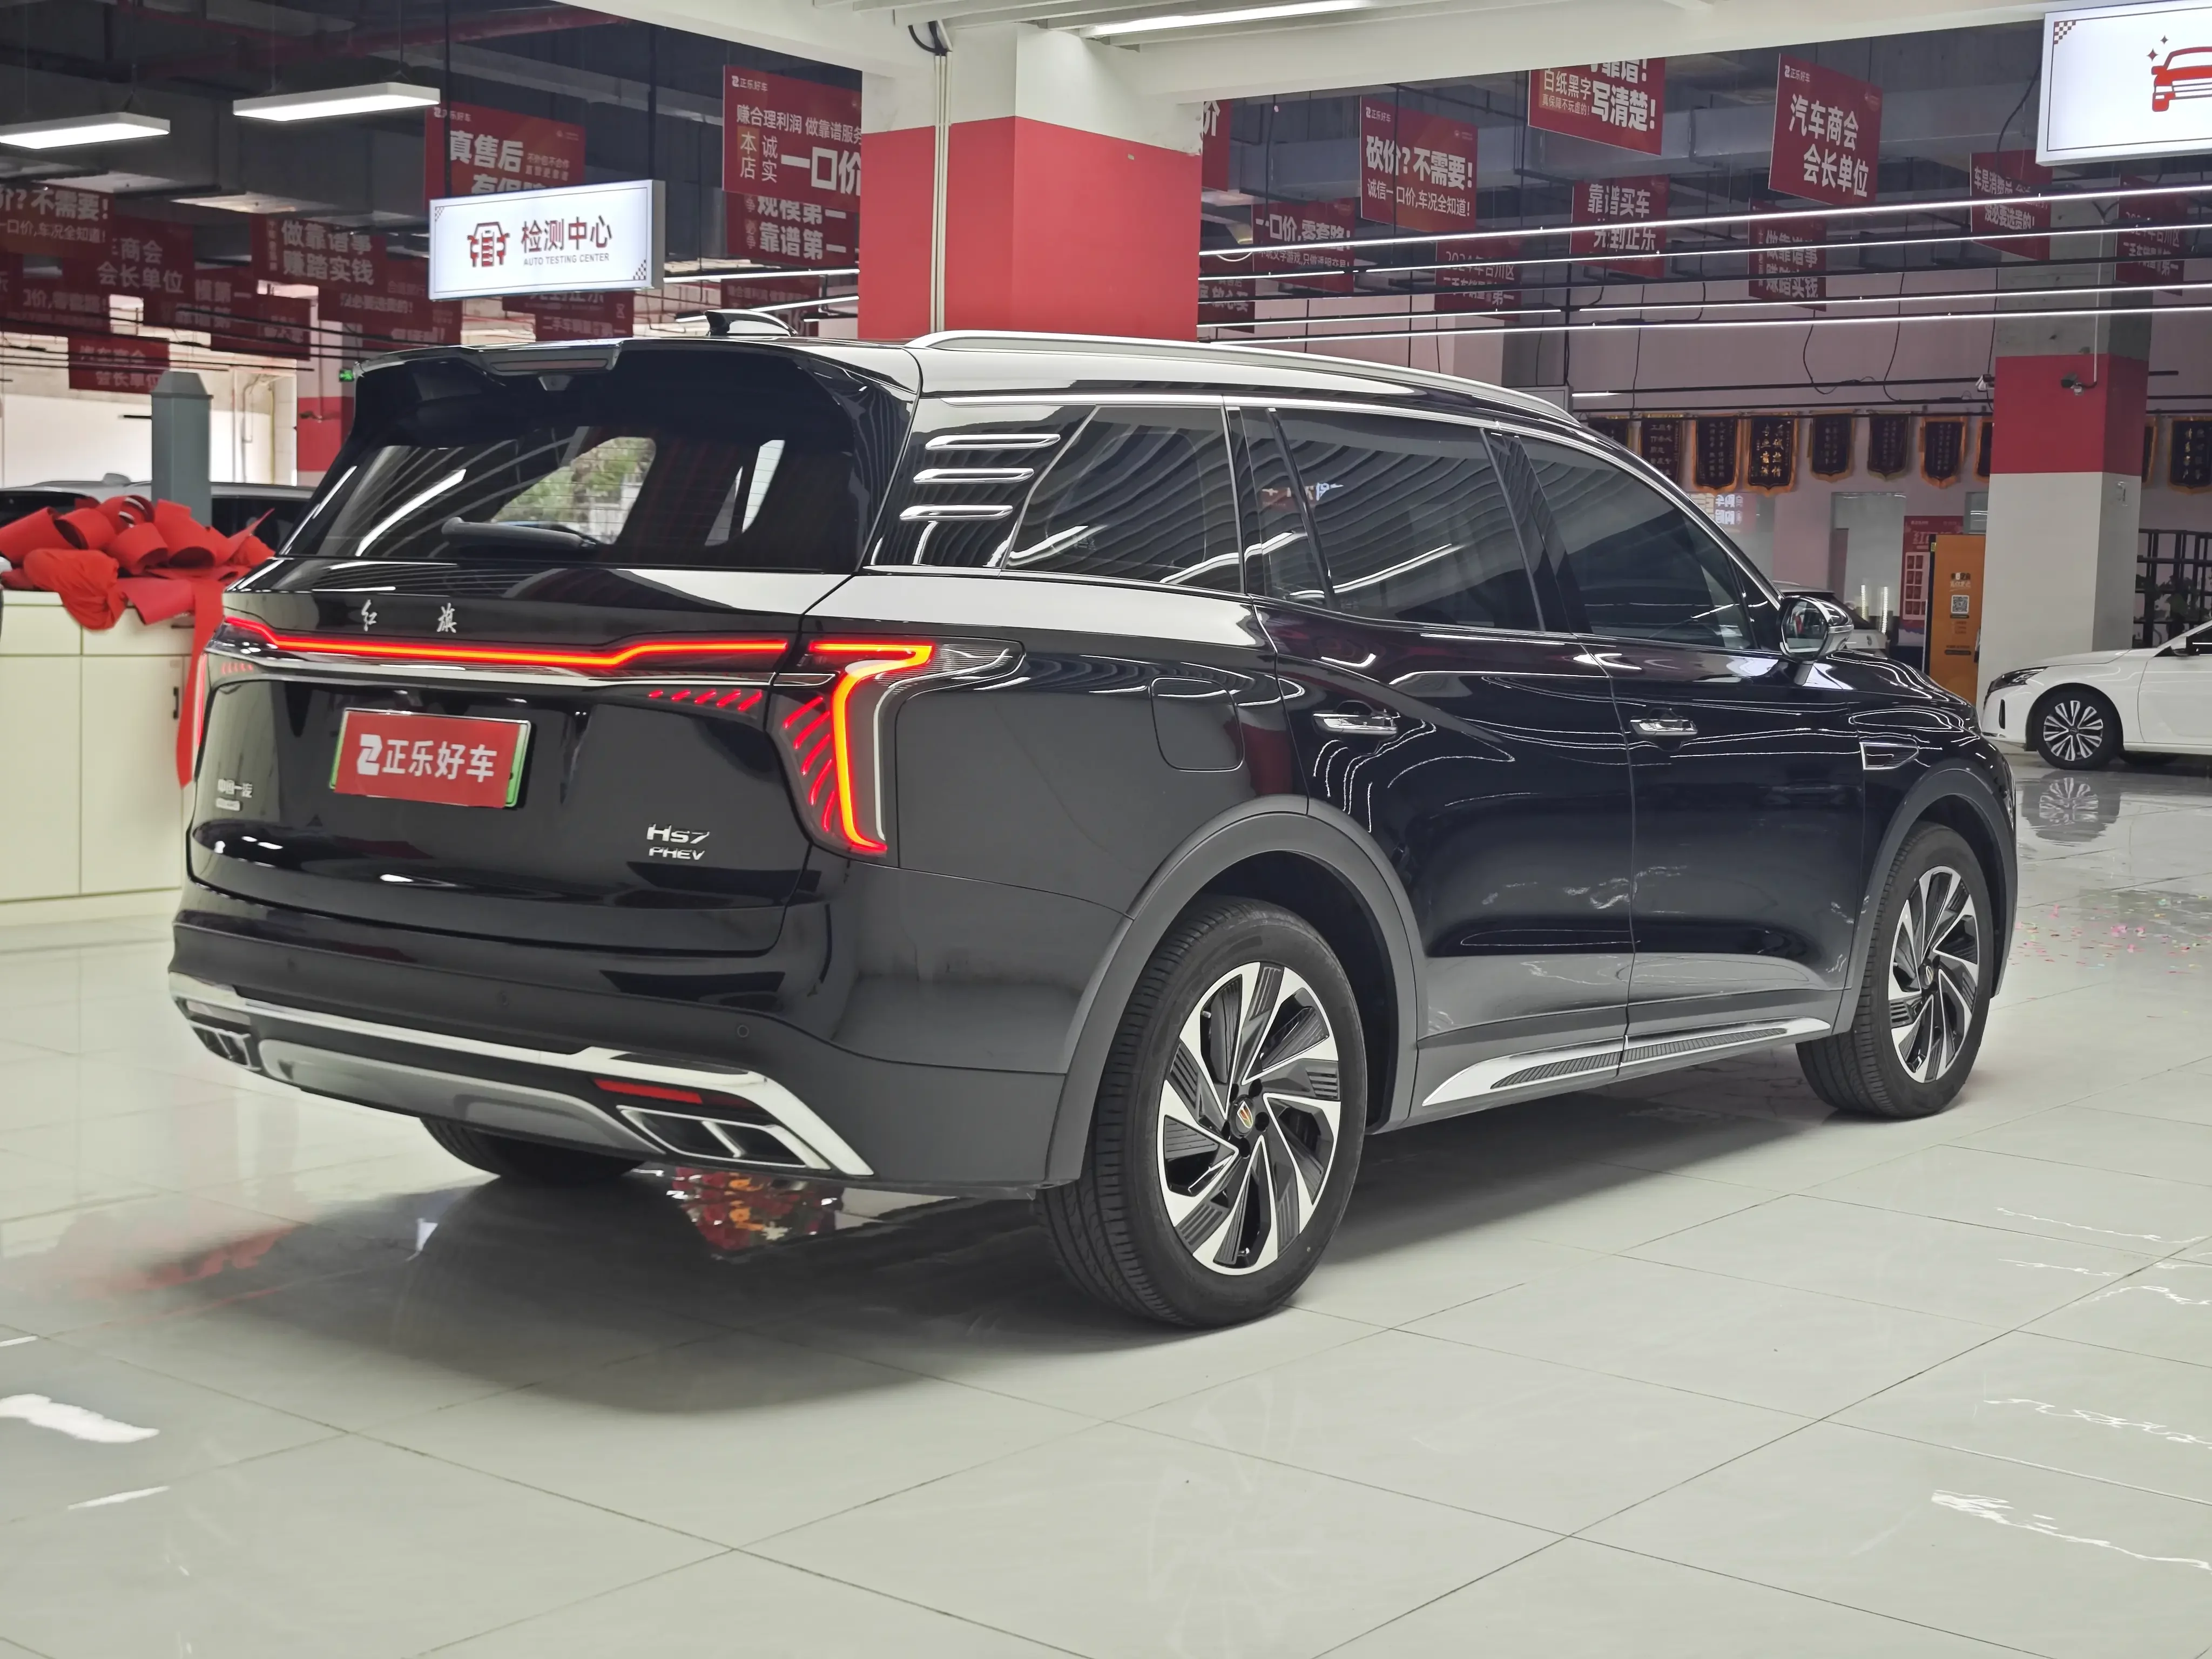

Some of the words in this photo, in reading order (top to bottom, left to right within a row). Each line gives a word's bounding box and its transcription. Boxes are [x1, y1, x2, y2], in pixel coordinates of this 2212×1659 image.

[1544, 68, 1591, 100] 白纸黑字
[737, 104, 802, 134] 赚合理利润
[1789, 93, 1859, 151] 汽车商会
[450, 130, 524, 173] 真售后
[781, 146, 861, 196] 一口价
[1803, 144, 1869, 197] 会长单位
[1588, 184, 1651, 218] 靠谱买车
[521, 215, 612, 253] 检测中心
[759, 222, 847, 260] 靠谱第一
[97, 261, 184, 293] 会长单位
[523, 256, 544, 266] AUTO
[545, 254, 577, 265] TESTING
[579, 252, 610, 263] CENTER
[382, 739, 497, 783] 正乐好车
[646, 824, 710, 844] HS7
[649, 846, 705, 860] PHEV
